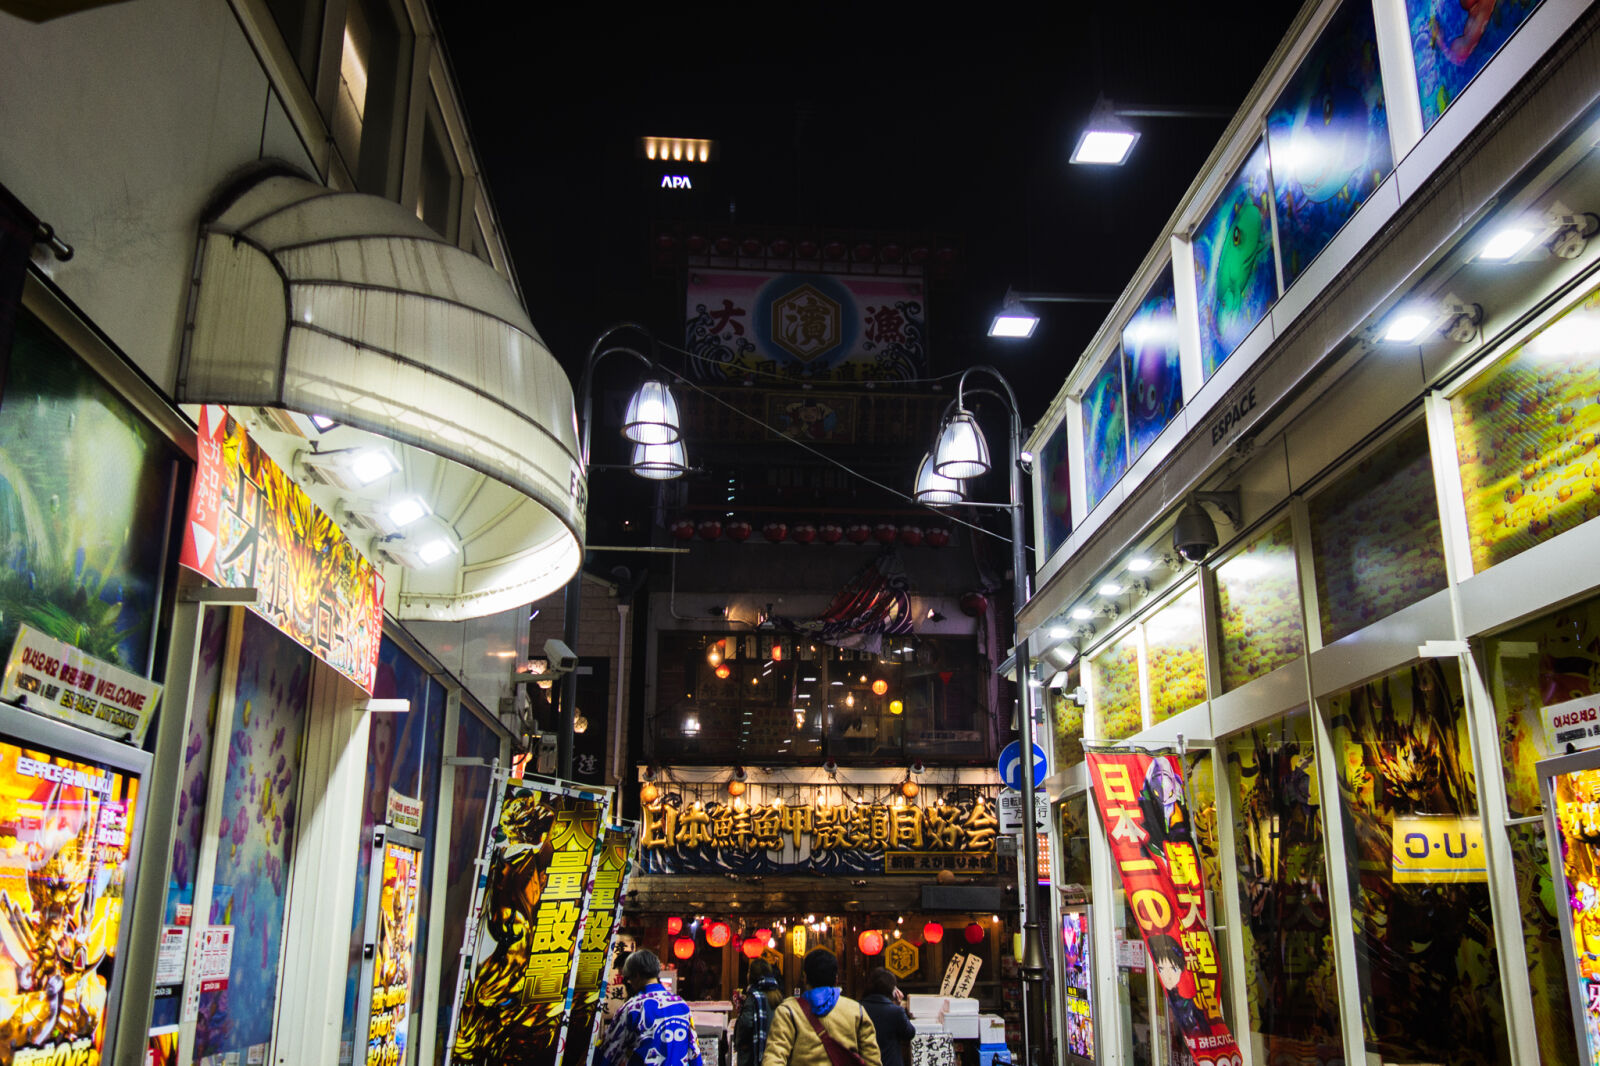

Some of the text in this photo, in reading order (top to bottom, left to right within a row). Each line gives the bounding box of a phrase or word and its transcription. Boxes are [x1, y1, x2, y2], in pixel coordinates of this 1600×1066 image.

[661, 174, 692, 190] APA
[709, 300, 906, 344] 大 漁
[1211, 386, 1257, 447] ESPACE
[195, 439, 211, 522] ここから
[21, 646, 59, 678] 어서오세요
[95, 677, 147, 711] WELCOME
[60, 688, 98, 716] ESPACE
[95, 702, 140, 730] NITTAKU
[1553, 707, 1598, 729] 어서오세요
[1001, 797, 1048, 809] 自転除く
[1002, 809, 1048, 819] 一方行
[641, 803, 999, 851] 日本鮮魚甲殻類同好会
[520, 800, 600, 1007] 大量設置
